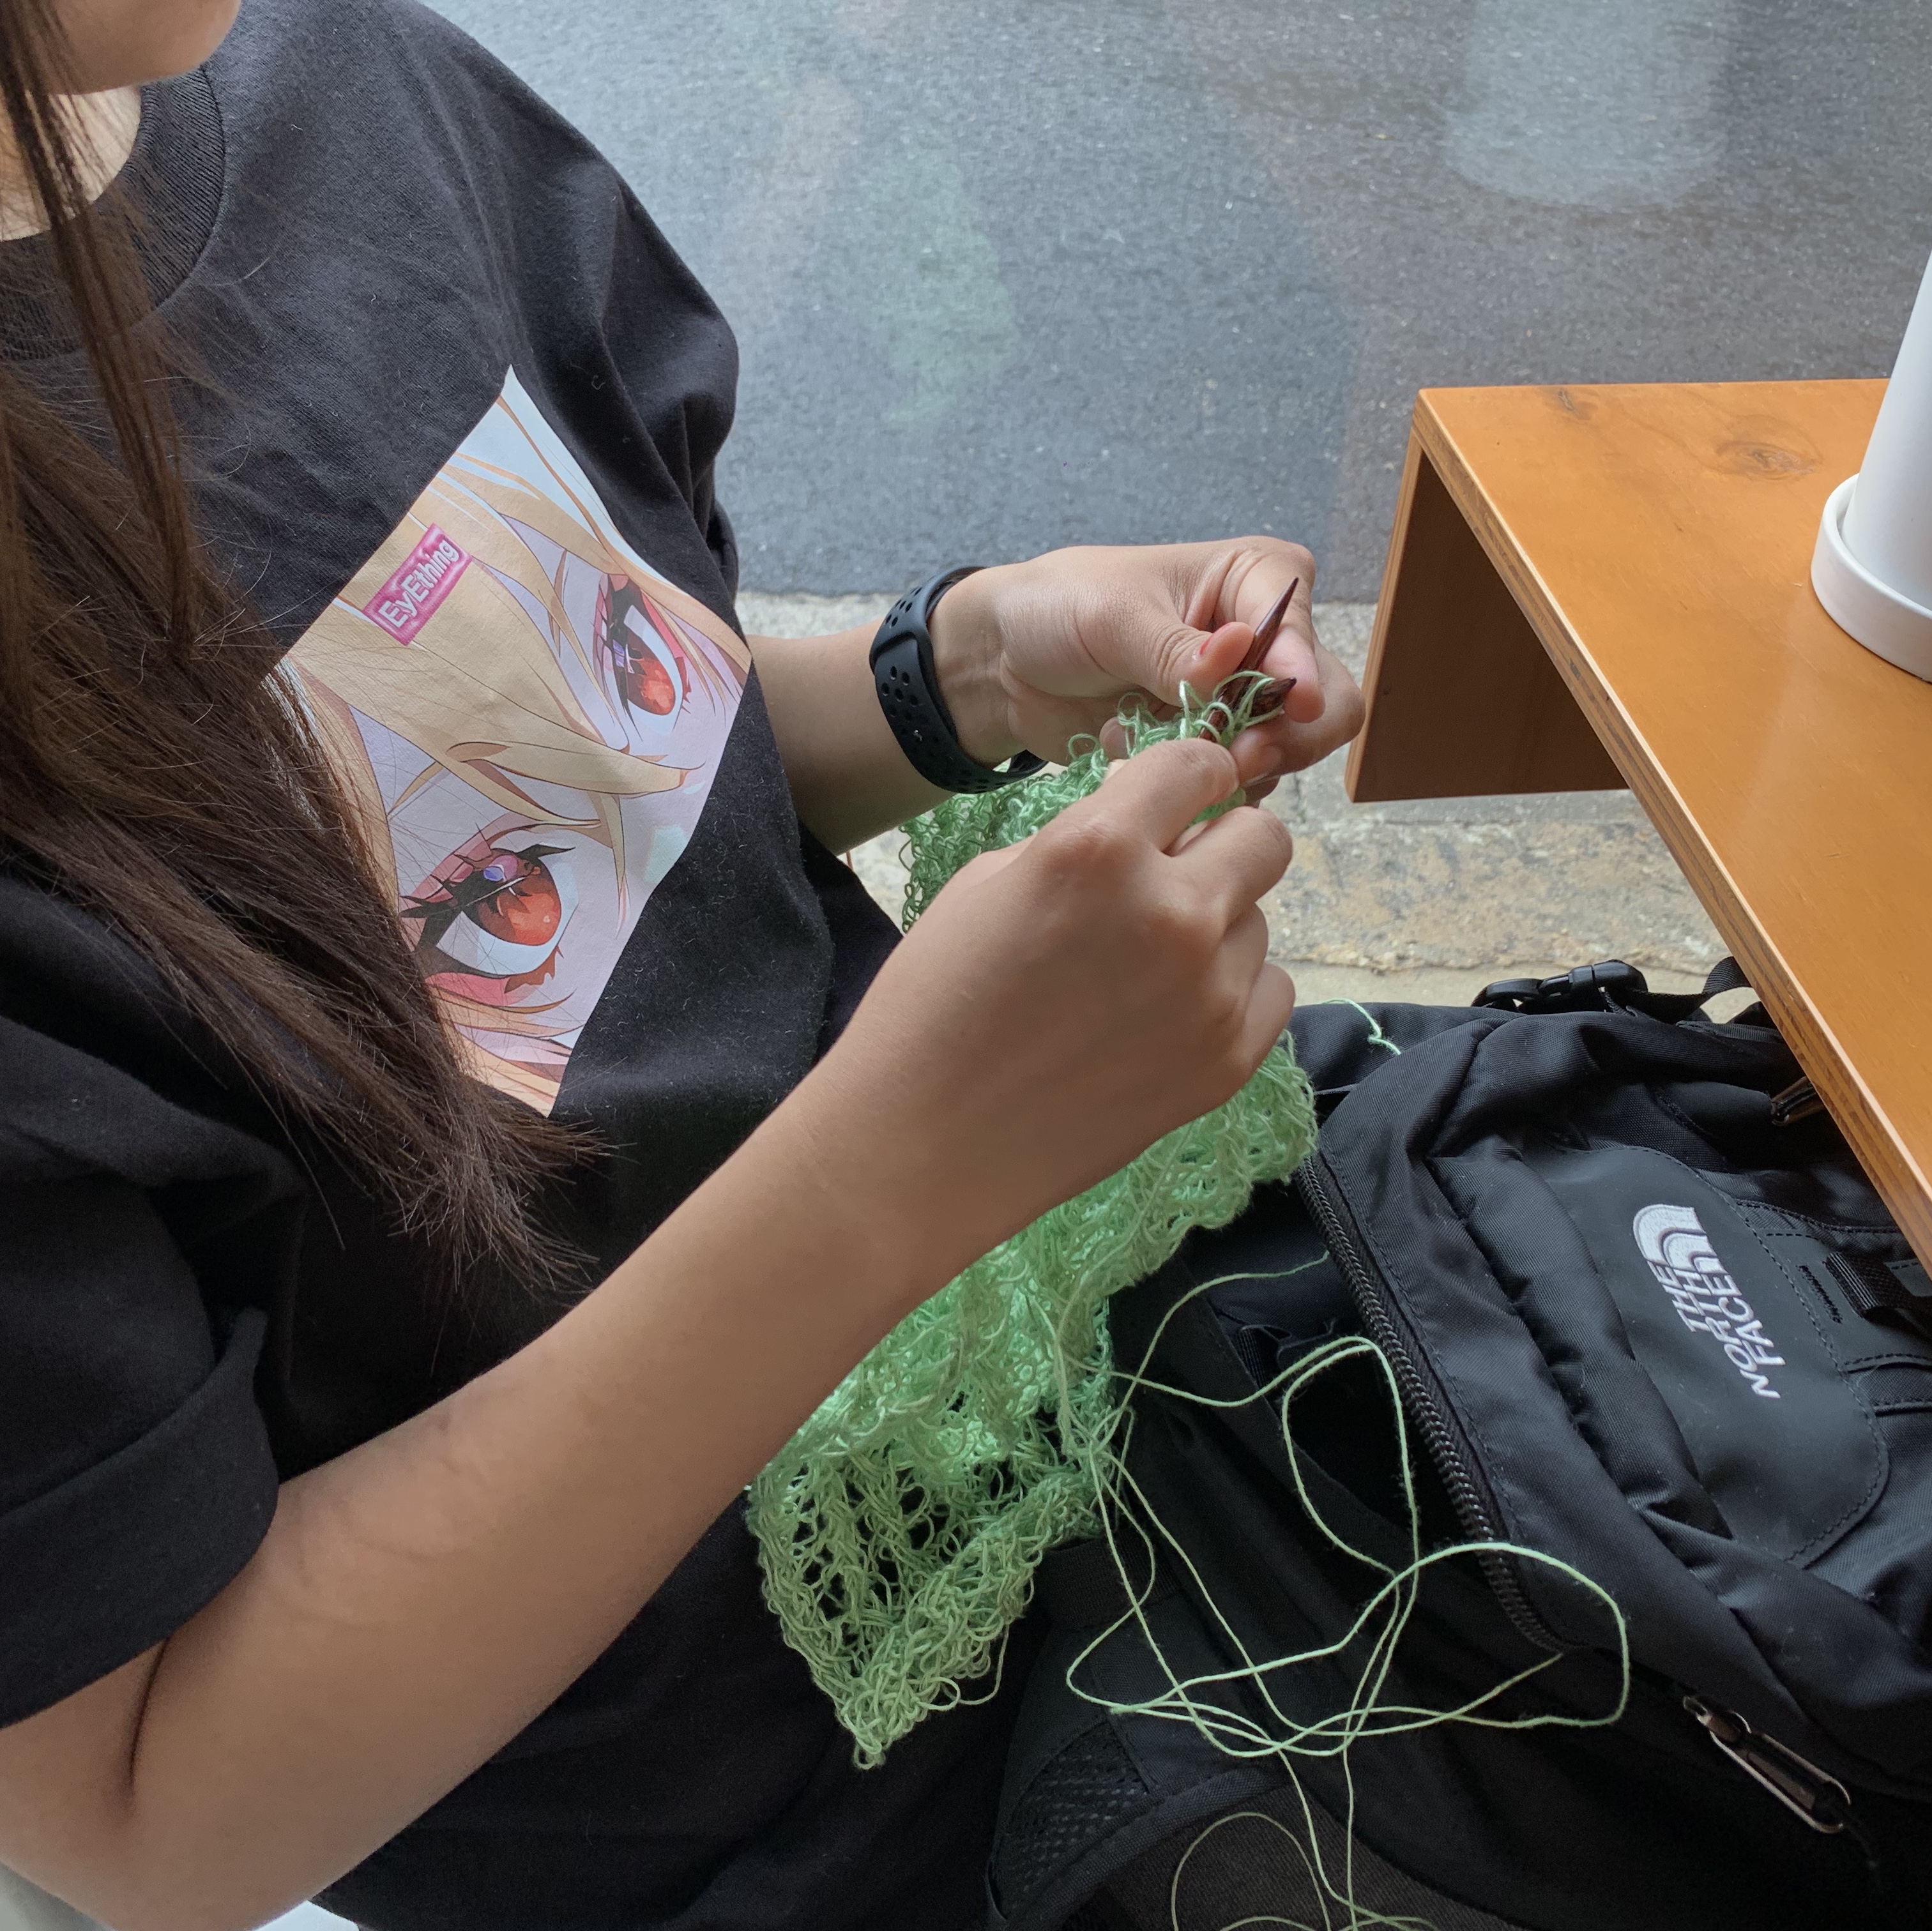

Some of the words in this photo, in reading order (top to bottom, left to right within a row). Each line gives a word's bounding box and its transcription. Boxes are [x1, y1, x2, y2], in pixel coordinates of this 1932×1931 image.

[378, 540, 460, 628] EyEthing
[1646, 1260, 1710, 1332] THE
[1671, 1268, 1781, 1398] NORTH
[1700, 1273, 1786, 1365] FACE
